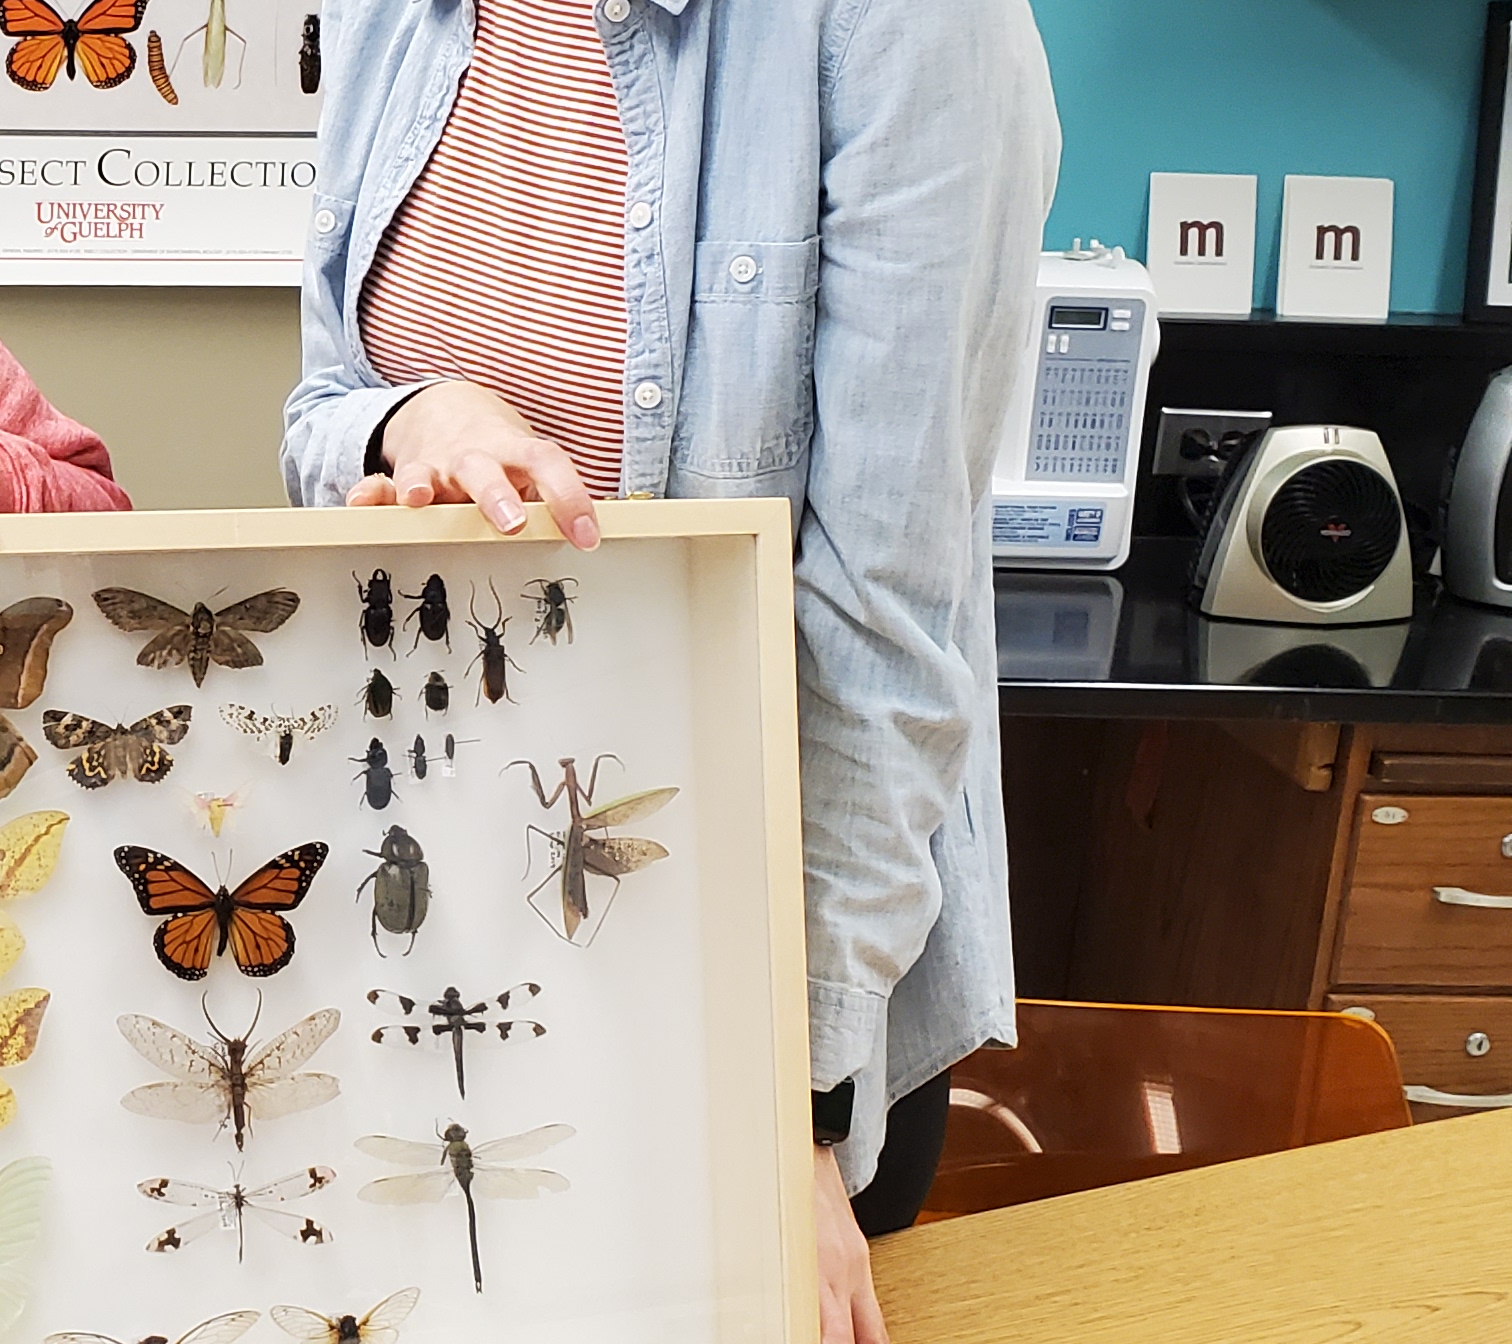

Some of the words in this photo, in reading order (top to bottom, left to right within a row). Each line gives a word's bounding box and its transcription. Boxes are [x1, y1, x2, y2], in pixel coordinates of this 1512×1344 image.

[35, 202, 165, 224] UNIVERSITY
[44, 221, 63, 238] of
[60, 221, 144, 243] GUELPH
[1179, 220, 1224, 257] m
[1315, 224, 1360, 261] m
